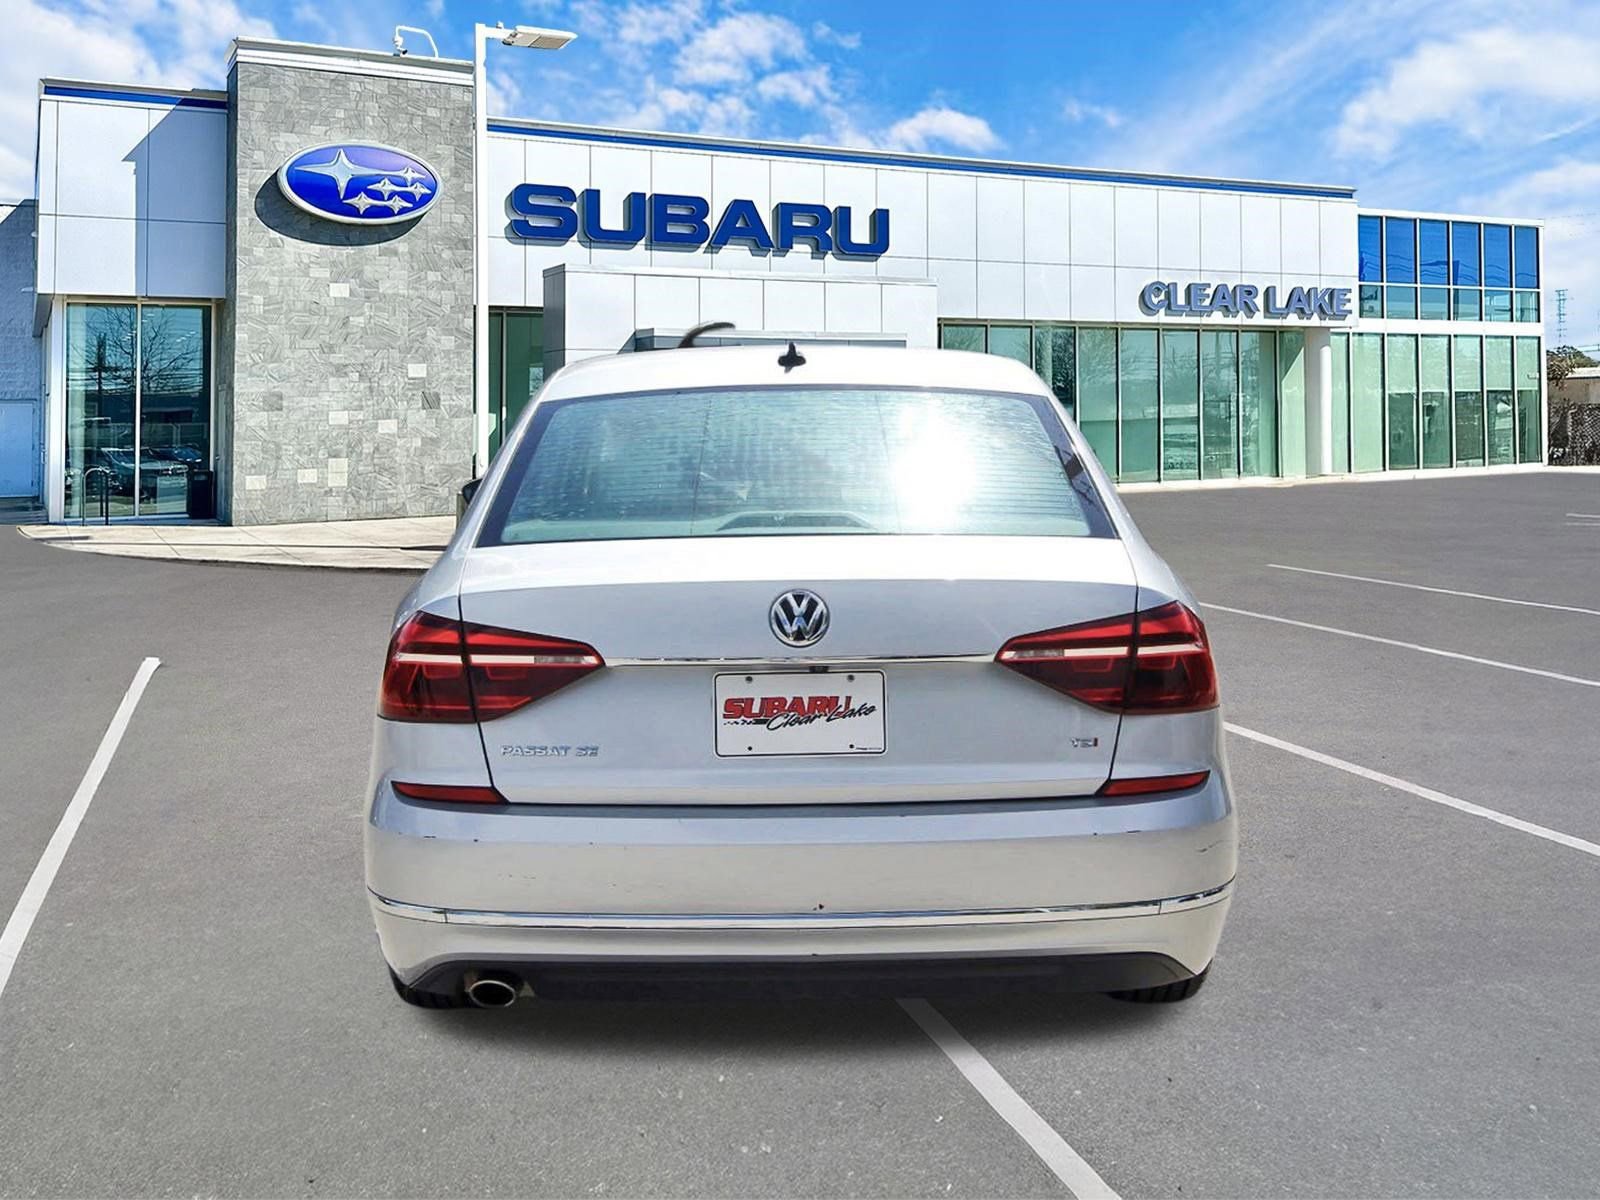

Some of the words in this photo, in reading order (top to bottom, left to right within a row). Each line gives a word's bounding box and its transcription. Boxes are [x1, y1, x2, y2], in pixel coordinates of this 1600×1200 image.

[506, 183, 889, 260] SUBARU
[1139, 281, 1260, 317] CLEAR
[1264, 286, 1352, 320] LAKE
[723, 696, 852, 719] SUBARU
[766, 712, 822, 731] Clear
[826, 703, 877, 722] Lake
[500, 745, 571, 757] PASSAT
